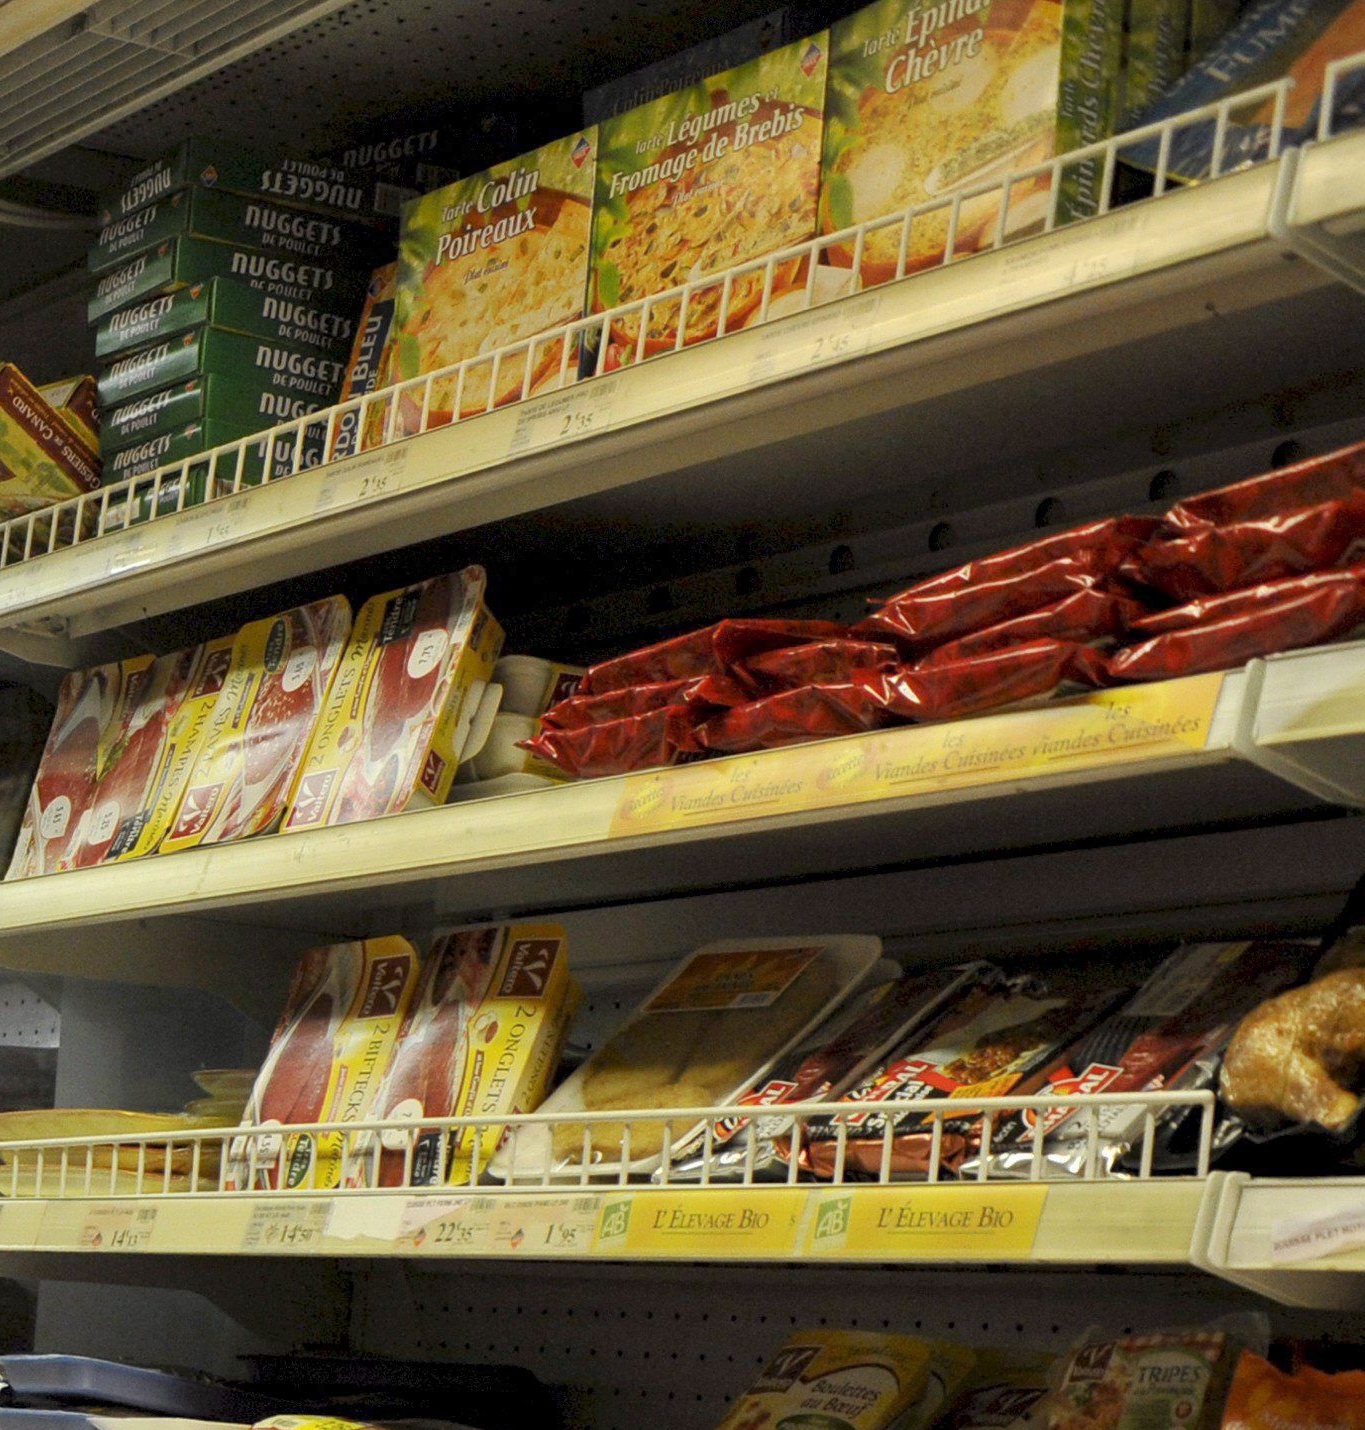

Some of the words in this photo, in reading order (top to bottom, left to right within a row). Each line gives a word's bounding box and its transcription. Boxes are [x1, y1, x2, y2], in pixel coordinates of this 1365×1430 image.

[861, 26, 899, 60] Tarte
[884, 25, 985, 94] Chèvre
[634, 133, 664, 156] Tarte
[665, 89, 761, 148] Légumes
[765, 85, 781, 104] et
[343, 130, 439, 168] NUGGETS
[608, 150, 699, 201] Fromage
[701, 132, 728, 165] de
[731, 103, 806, 153] Brebis
[260, 169, 364, 210] NUGGETS
[441, 200, 474, 224] Tarte
[475, 166, 540, 215] Colin
[99, 204, 159, 247] NUGGETS
[244, 204, 342, 247] NUGGETS
[434, 205, 538, 266] Poireaux
[96, 255, 147, 298] NUGGETS
[230, 251, 334, 291] NUGGETS
[109, 294, 174, 334] NUGGETS
[262, 296, 352, 339] NUGGETS
[278, 324, 293, 338] DE
[292, 327, 334, 350] POULET
[352, 314, 383, 381] BLEU
[109, 342, 171, 380] NUGGETS
[255, 345, 348, 385] NUGGET
[272, 372, 288, 387] DE
[289, 376, 333, 397] POULET
[12, 395, 54, 441] CANARD
[110, 389, 174, 428] NUGGETS
[113, 432, 174, 471] NUGGETS
[203, 698, 216, 712] 2
[315, 664, 358, 747] ONGLETS
[1105, 701, 1132, 723] les
[942, 730, 966, 749] les
[1106, 711, 1202, 746] Cuisinées
[169, 710, 205, 797] HAMPES
[310, 750, 324, 767] 2
[874, 757, 940, 783] Viandes
[941, 743, 1027, 773] Cuisinées
[671, 788, 728, 813] Viandes
[730, 777, 804, 806] Cuisinées
[729, 765, 751, 786] les
[189, 785, 221, 839] Valtero
[305, 773, 339, 825] Valtero
[502, 943, 534, 996] Valtero
[371, 1022, 390, 1036] 2
[514, 1004, 538, 1021] 2
[340, 1038, 384, 1125] BIFTECKS
[479, 1021, 529, 1116] ONGLETS
[652, 1209, 668, 1230] L'
[669, 1198, 737, 1230] ÉLEVAGE
[739, 1210, 771, 1229] BIO
[875, 1206, 895, 1229] L'
[895, 1199, 977, 1229] ÉLEVAGE
[978, 1205, 1017, 1229] BIO
[810, 1378, 883, 1402] Boulettes
[1137, 1366, 1202, 1384] TRIPES
